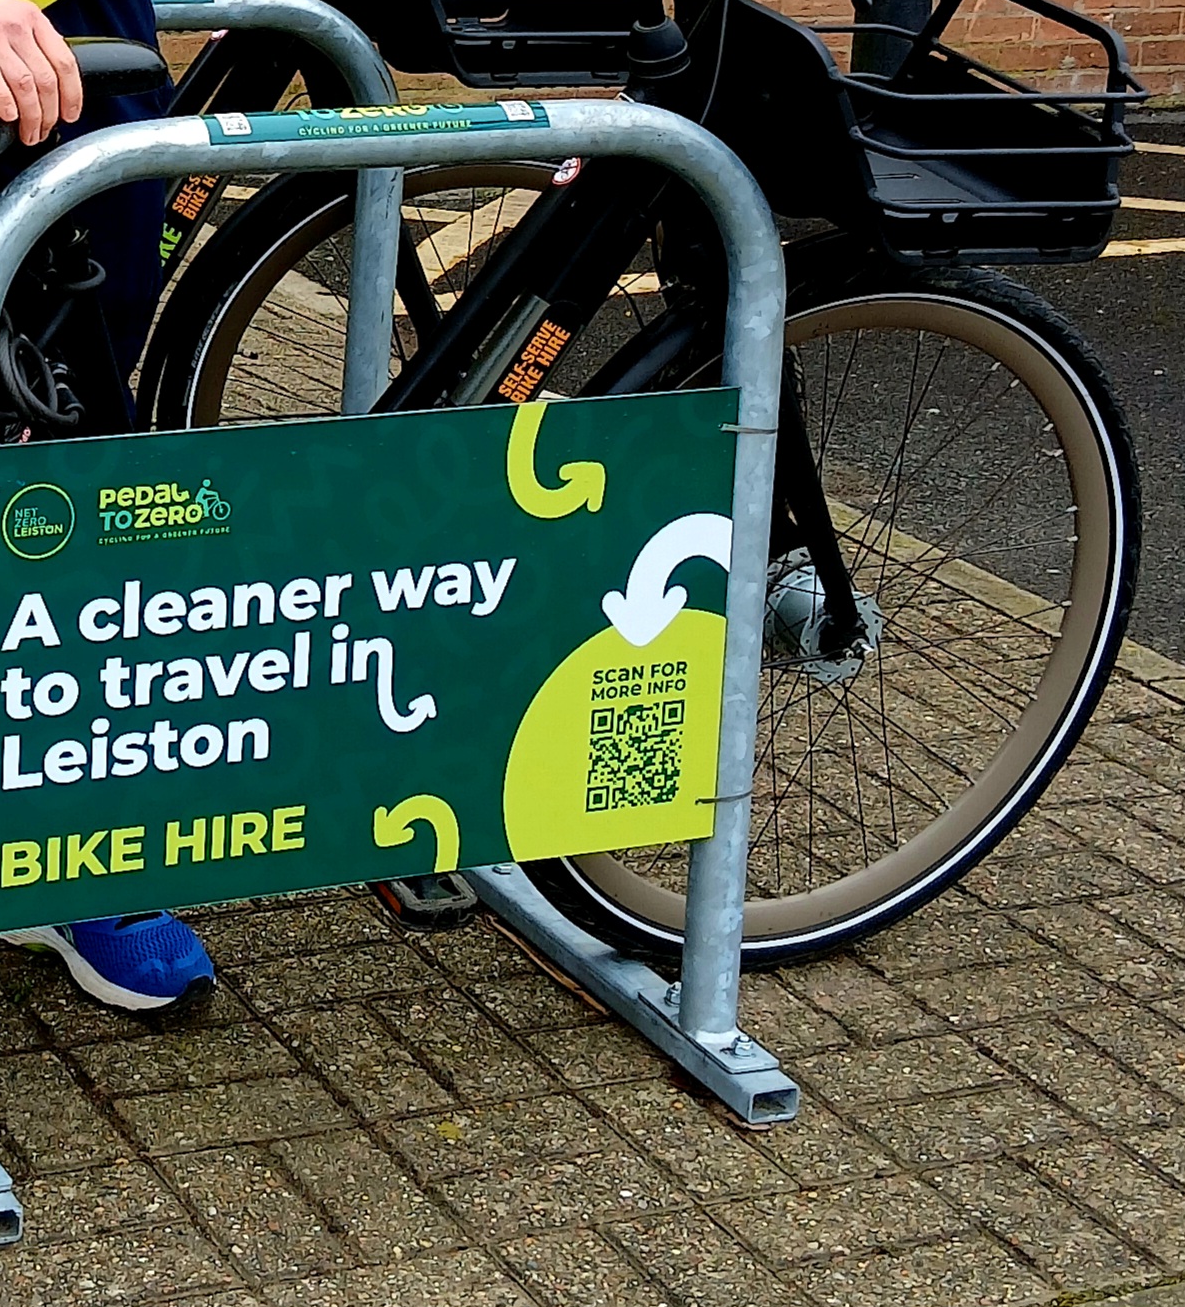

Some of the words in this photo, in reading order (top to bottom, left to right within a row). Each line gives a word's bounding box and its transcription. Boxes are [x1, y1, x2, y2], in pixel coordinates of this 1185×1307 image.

[299, 126, 345, 136] CYCLING
[348, 124, 368, 134] FOR
[372, 124, 379, 132] A
[382, 121, 429, 132] GREENER
[432, 120, 472, 130] FUTURE
[182, 187, 209, 220] BIKE
[498, 319, 557, 397] SELF-SERVE
[510, 366, 544, 403] BIKE
[536, 326, 571, 367] HIRE
[15, 508, 38, 518] NET
[15, 516, 47, 528] ZERO
[14, 524, 64, 537] LEISTON
[1, 593, 61, 651] A
[78, 573, 353, 642] cleaner
[371, 558, 517, 616] way
[0, 667, 79, 720] to
[100, 631, 311, 709] travel
[651, 661, 688, 678] FOR
[647, 679, 686, 695] INFO
[1, 717, 270, 790] Leiston
[1, 826, 145, 888] BIKE
[165, 805, 306, 866] HIRE
